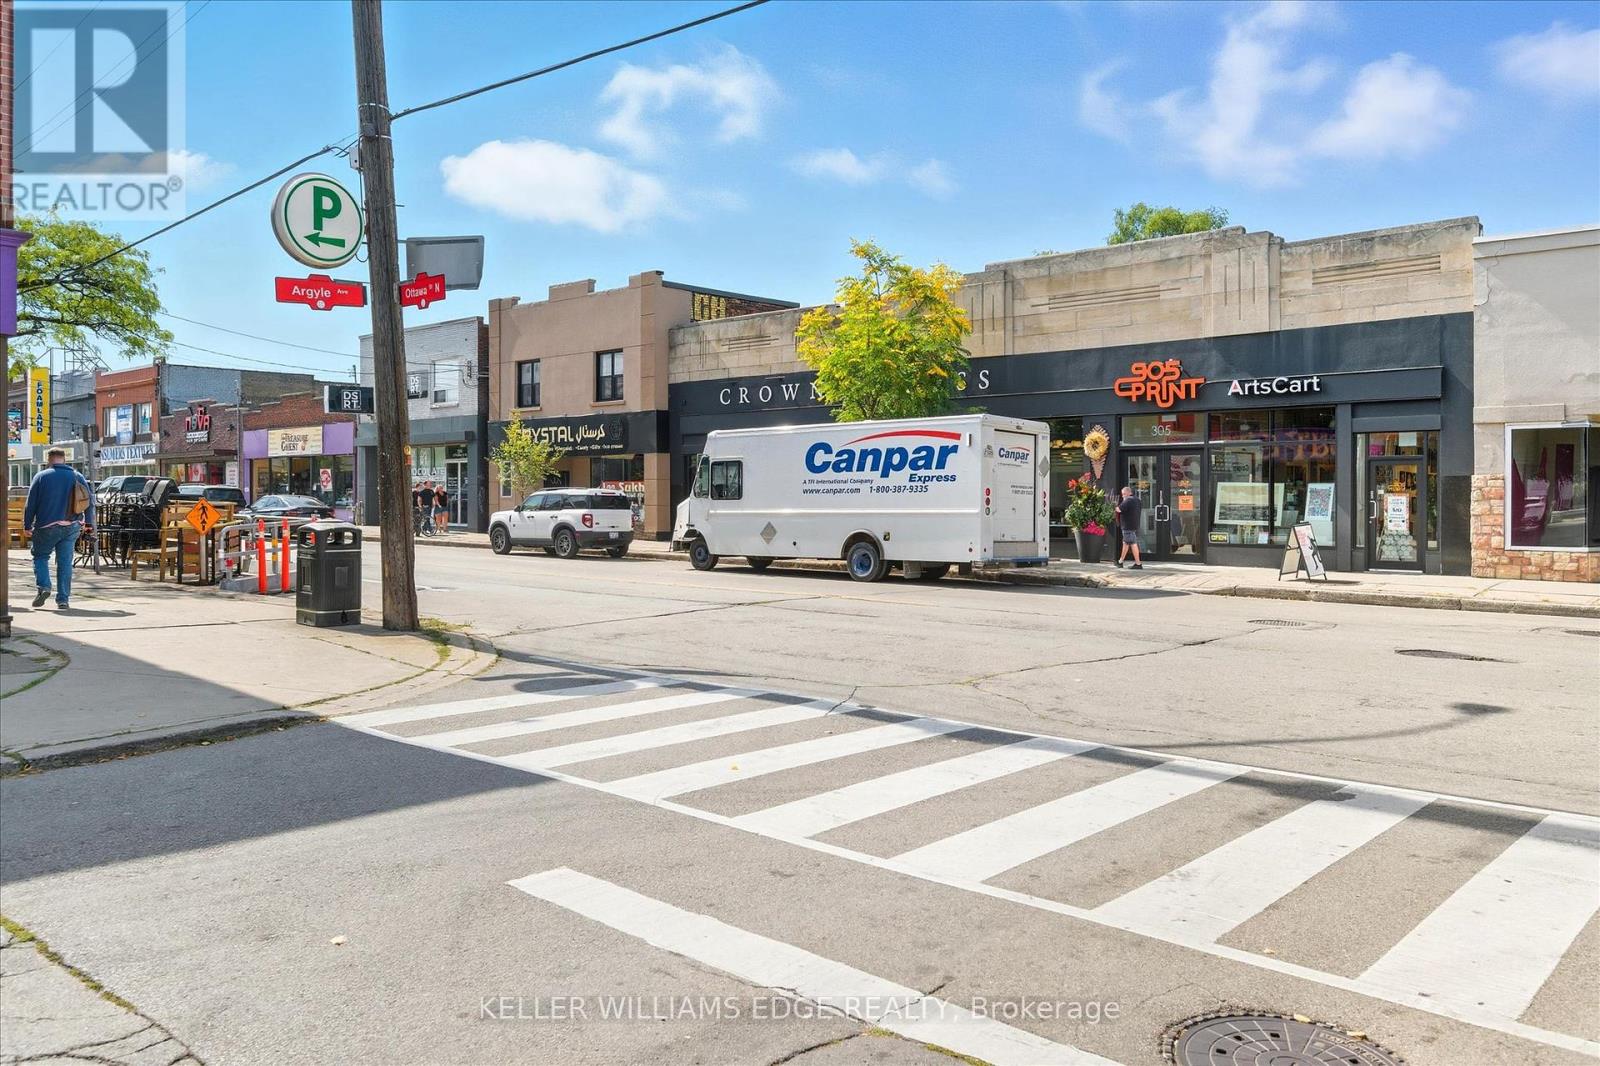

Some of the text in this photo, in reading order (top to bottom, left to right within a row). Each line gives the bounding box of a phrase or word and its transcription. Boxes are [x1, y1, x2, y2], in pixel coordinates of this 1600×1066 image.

[313, 185, 342, 231] P
[291, 285, 331, 298] Argyle
[405, 287, 427, 298] Ottawa
[434, 283, 440, 293] N
[1131, 359, 1181, 381] 905
[1228, 376, 1320, 396] ArtsCart
[343, 391, 359, 400] DS
[1151, 425, 1171, 437] 305
[805, 441, 958, 478] Canpar
[998, 447, 1030, 461] Canpar
[908, 473, 957, 484] Express
[803, 485, 929, 495] www.canpar.com 1-800-387-9335
